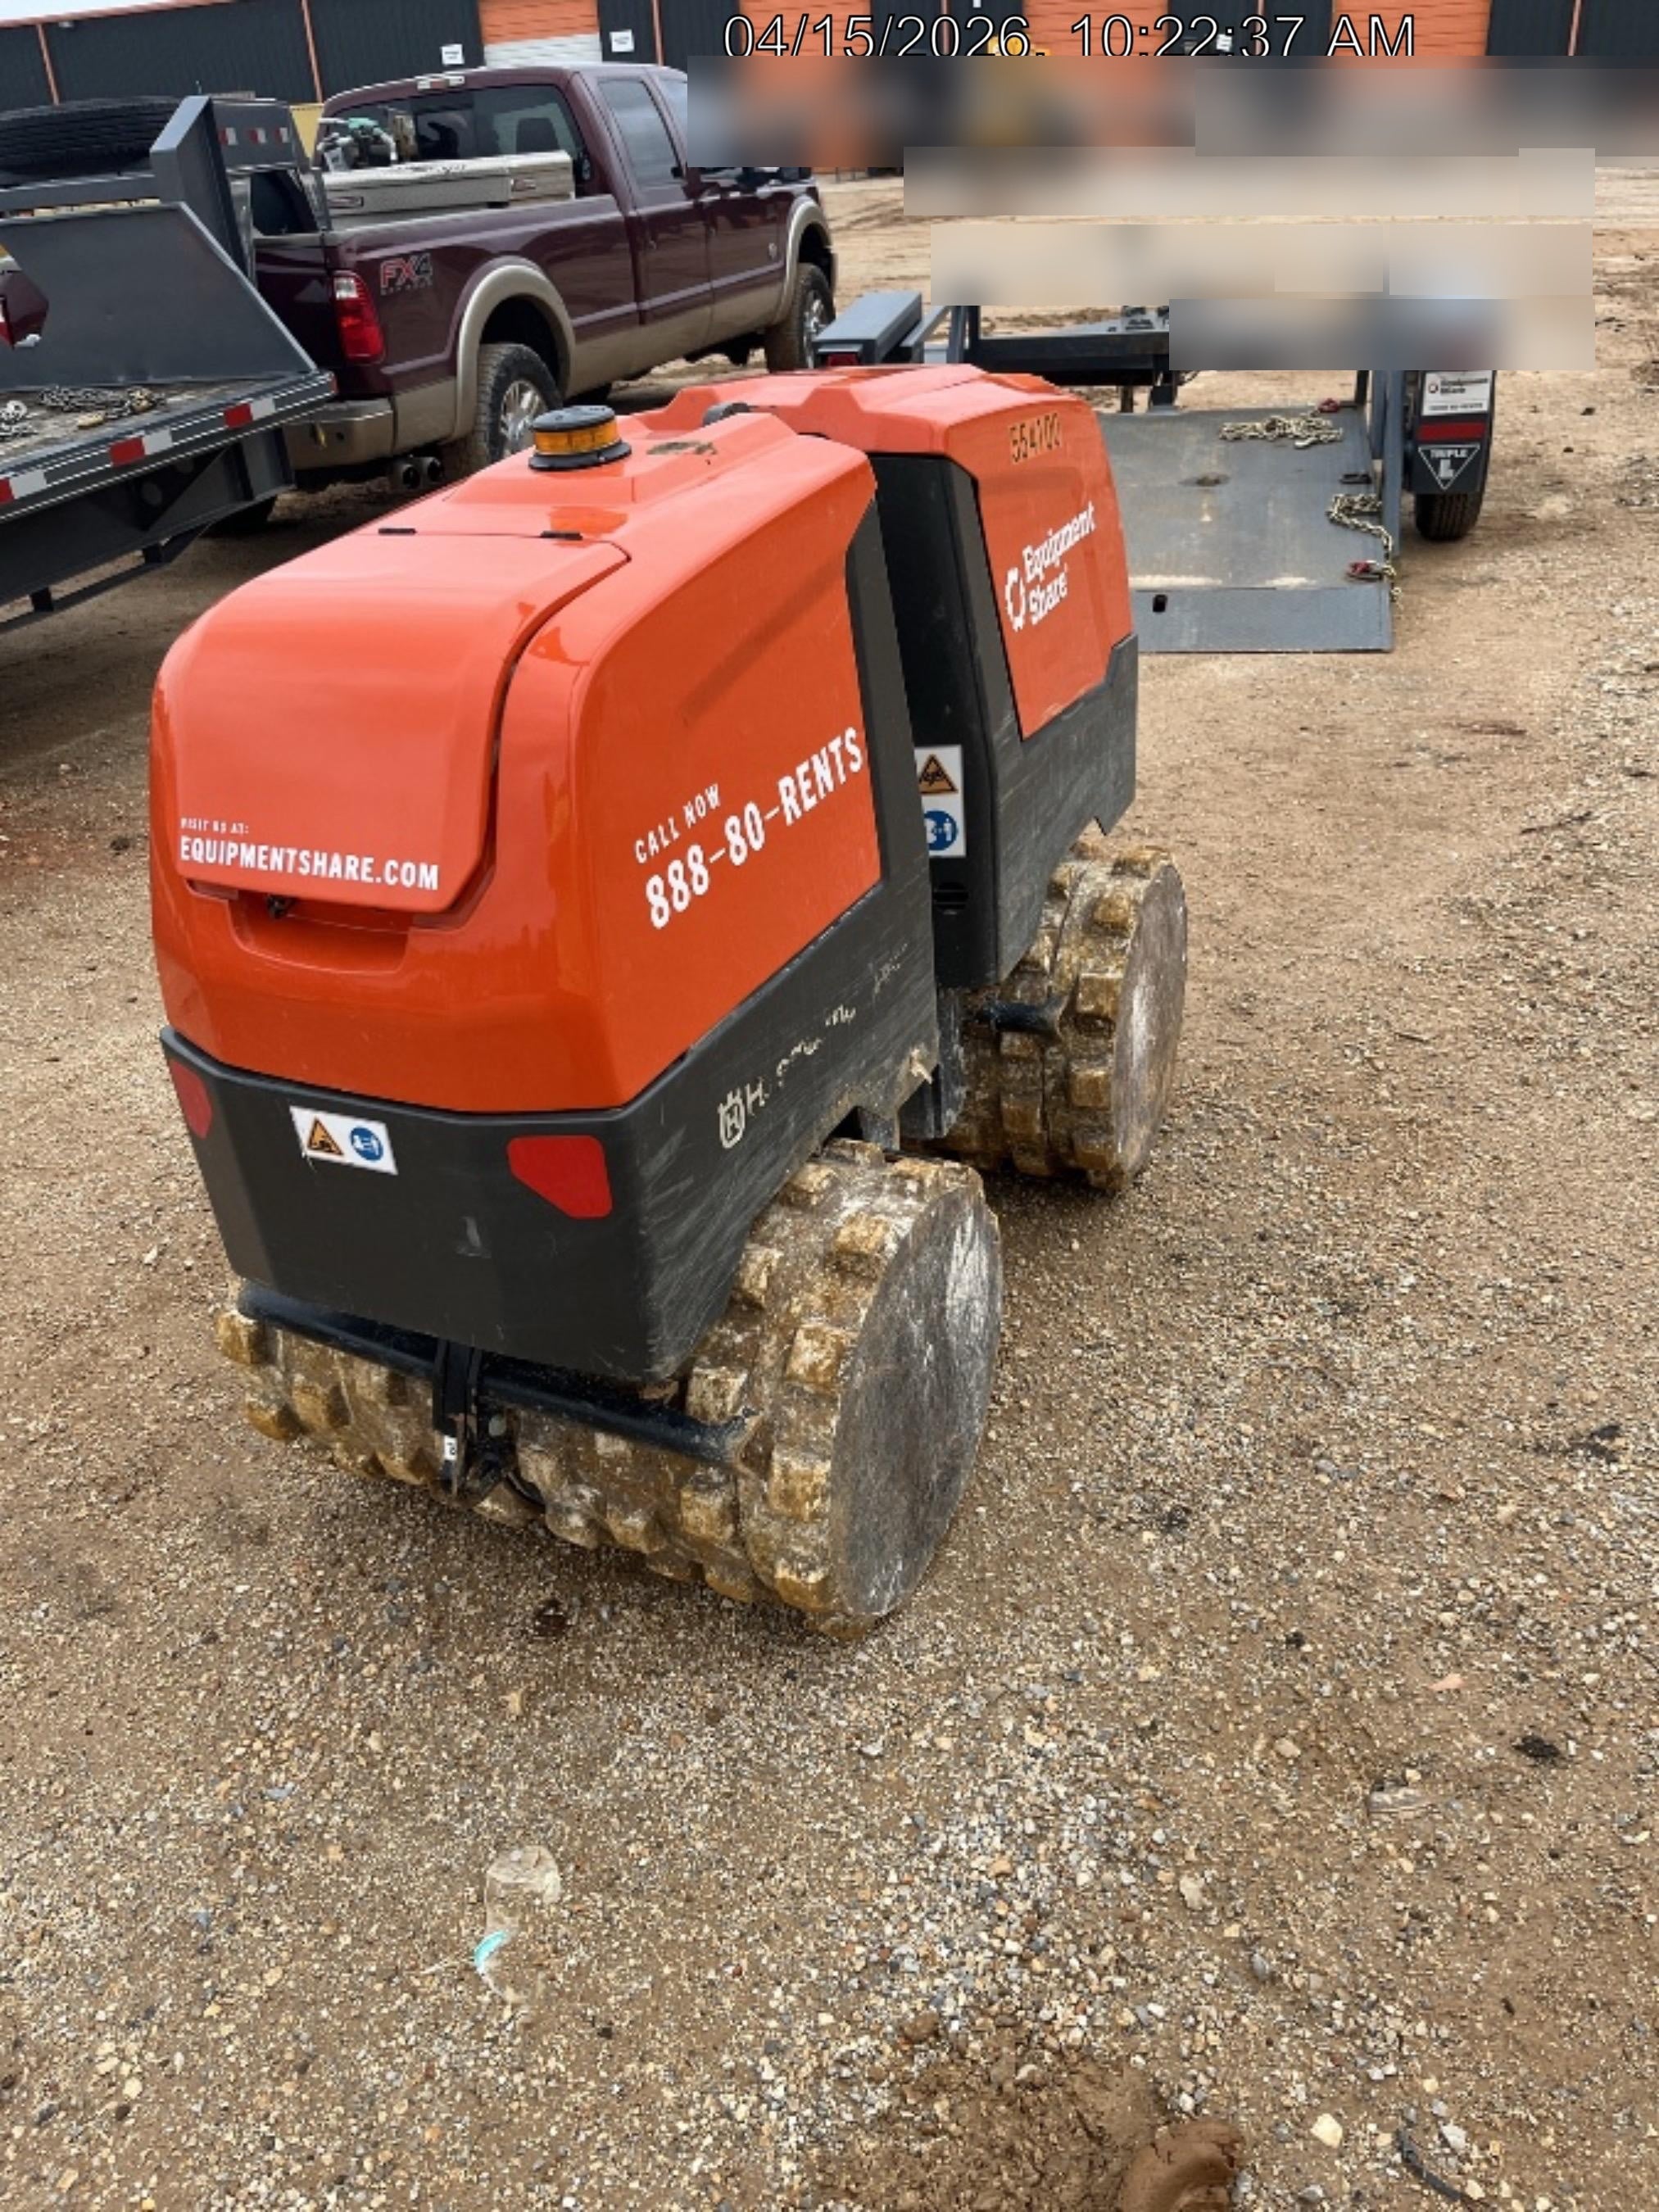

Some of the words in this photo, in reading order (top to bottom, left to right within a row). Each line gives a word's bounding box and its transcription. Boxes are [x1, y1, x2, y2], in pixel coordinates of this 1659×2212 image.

[380, 252, 433, 288] FX4
[1022, 501, 1095, 583] Equipment
[1028, 570, 1068, 625] Share
[635, 817, 680, 863] CALL
[682, 783, 721, 829] NOW
[646, 727, 863, 929] 888-80-RENTS
[180, 835, 439, 891] EQUIPMENTSHARE.COM
